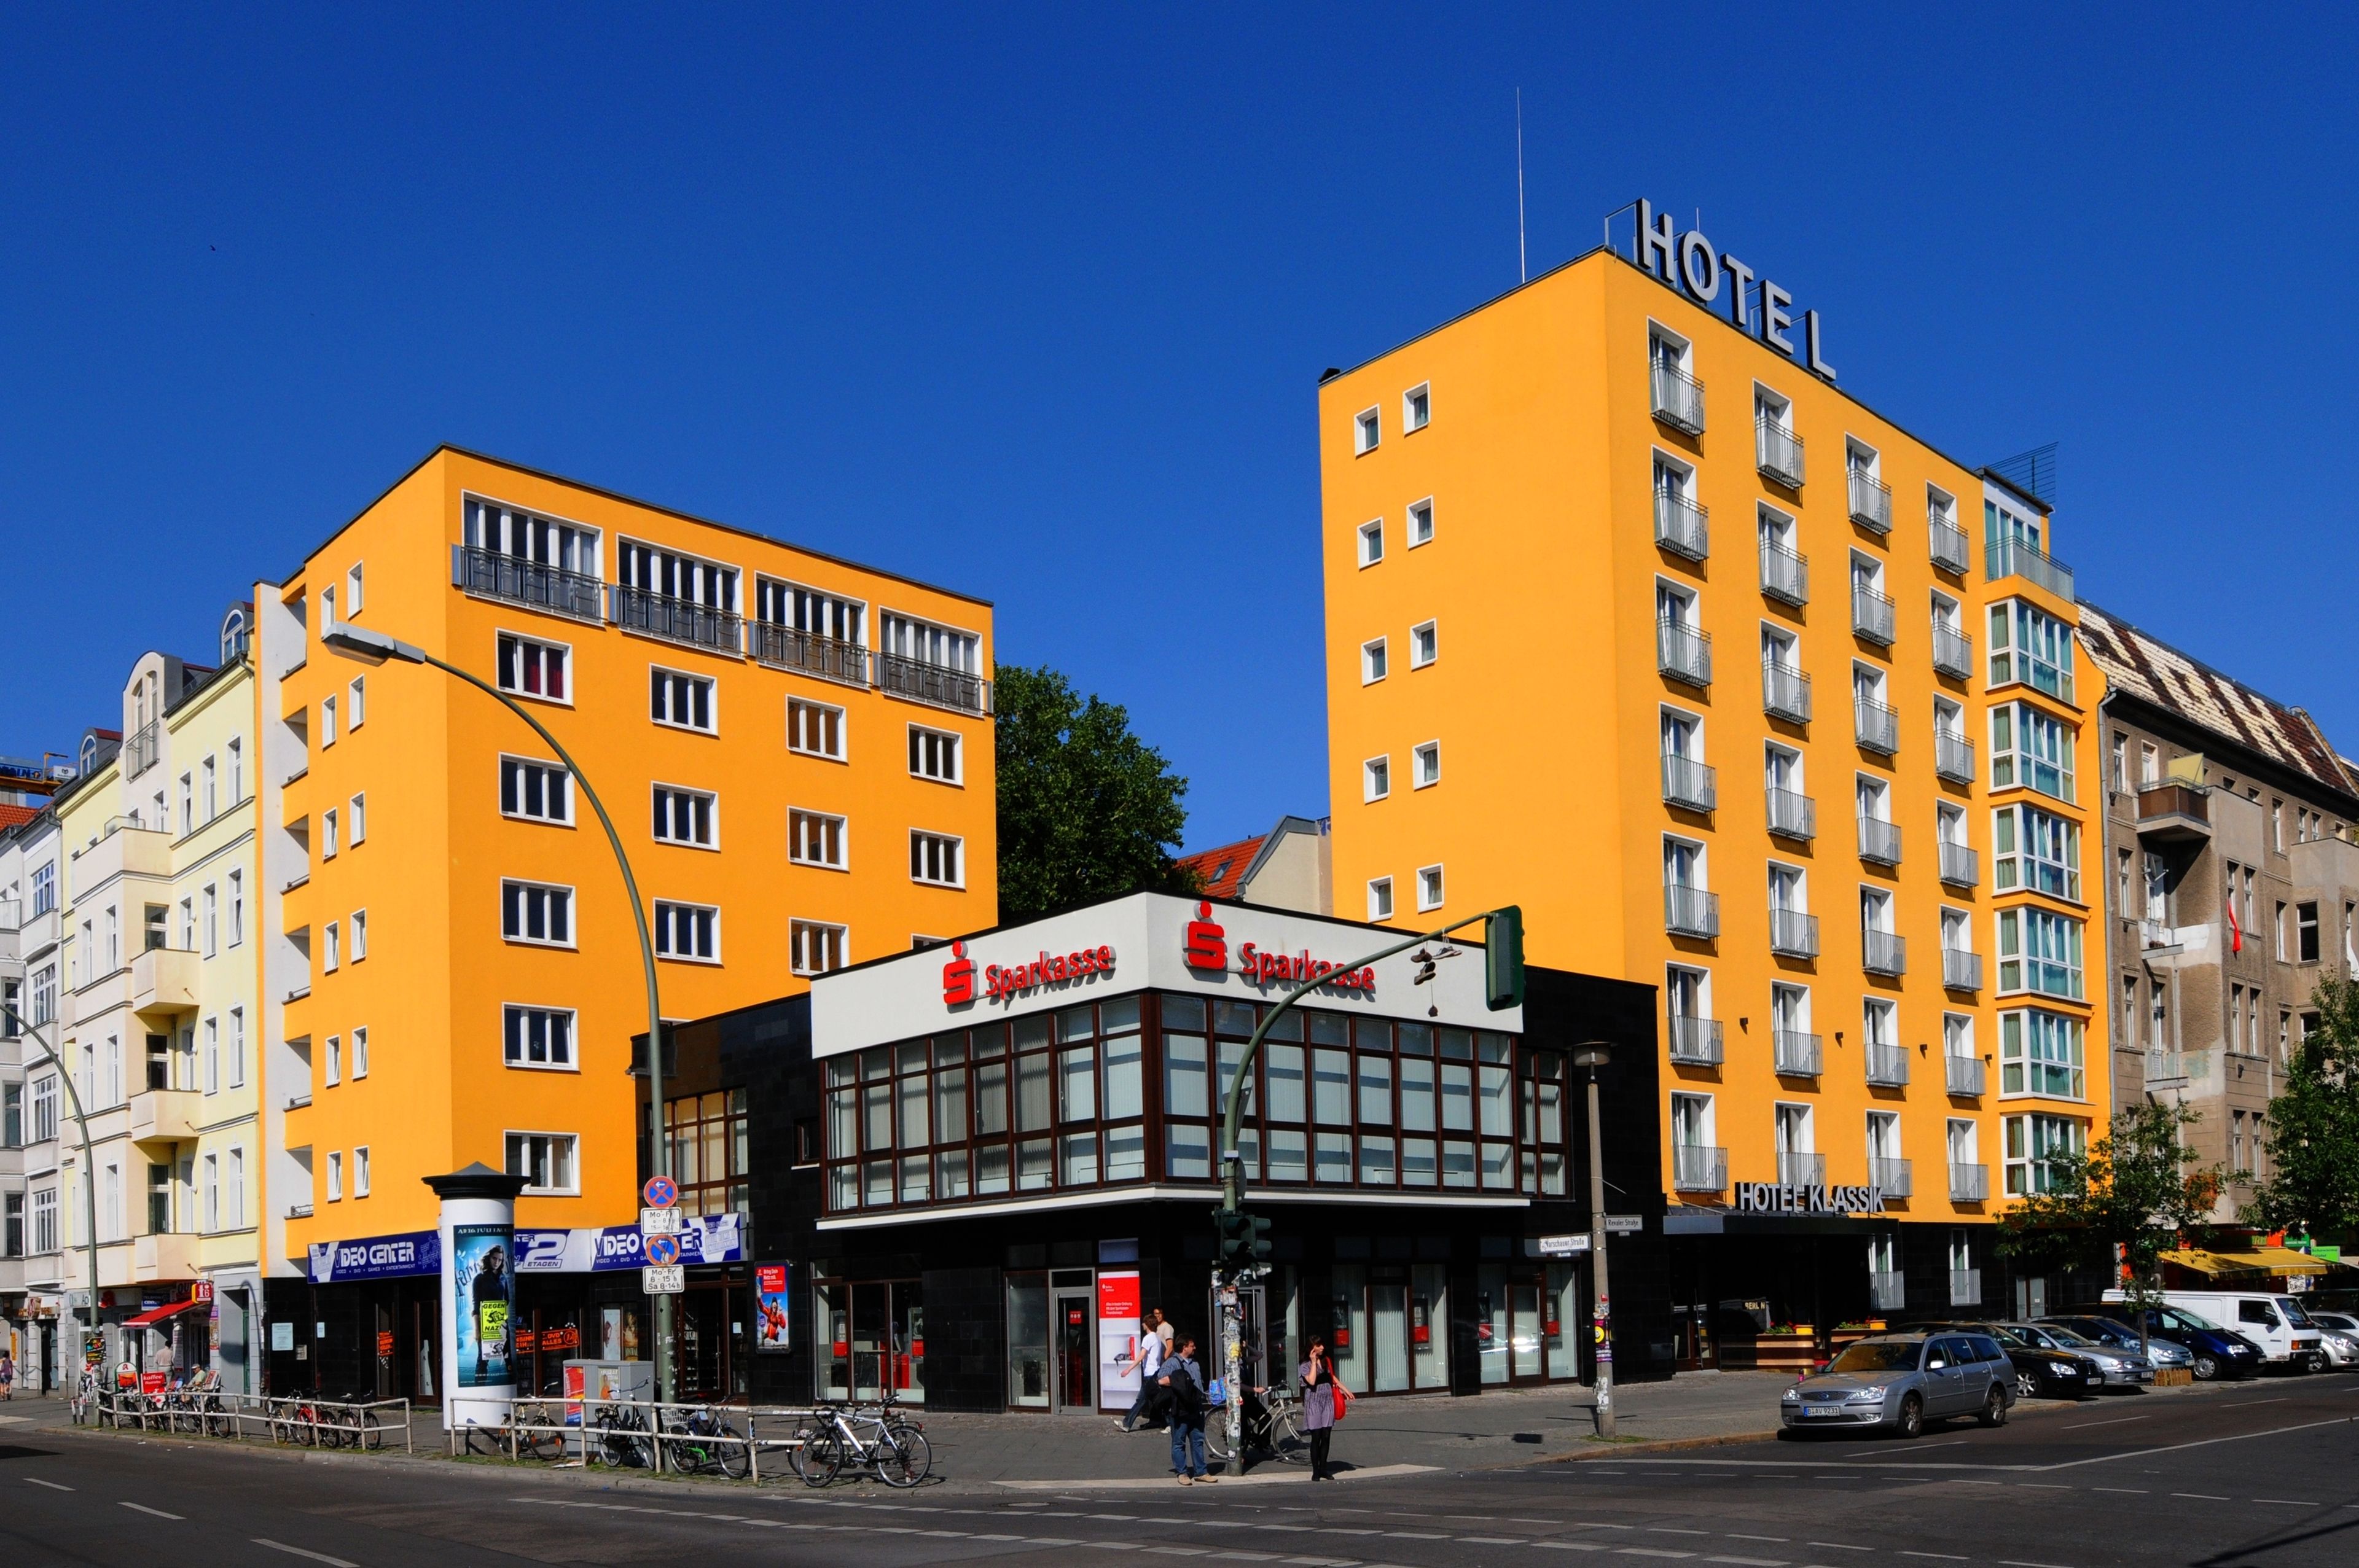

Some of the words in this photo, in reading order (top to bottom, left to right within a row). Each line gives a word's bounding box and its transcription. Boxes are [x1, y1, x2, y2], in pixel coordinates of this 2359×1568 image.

[1637, 197, 1836, 381] HOTEL
[985, 945, 1111, 1000] Sparkasse
[1242, 942, 1375, 990] Sparkasse
[1737, 1182, 1805, 1211] HOTEL
[1809, 1185, 1886, 1213] KLASSIK
[334, 1246, 367, 1268] VIDEO
[369, 1242, 414, 1265] CENTER
[523, 1233, 567, 1262] 2
[595, 1233, 640, 1257] VIDEO
